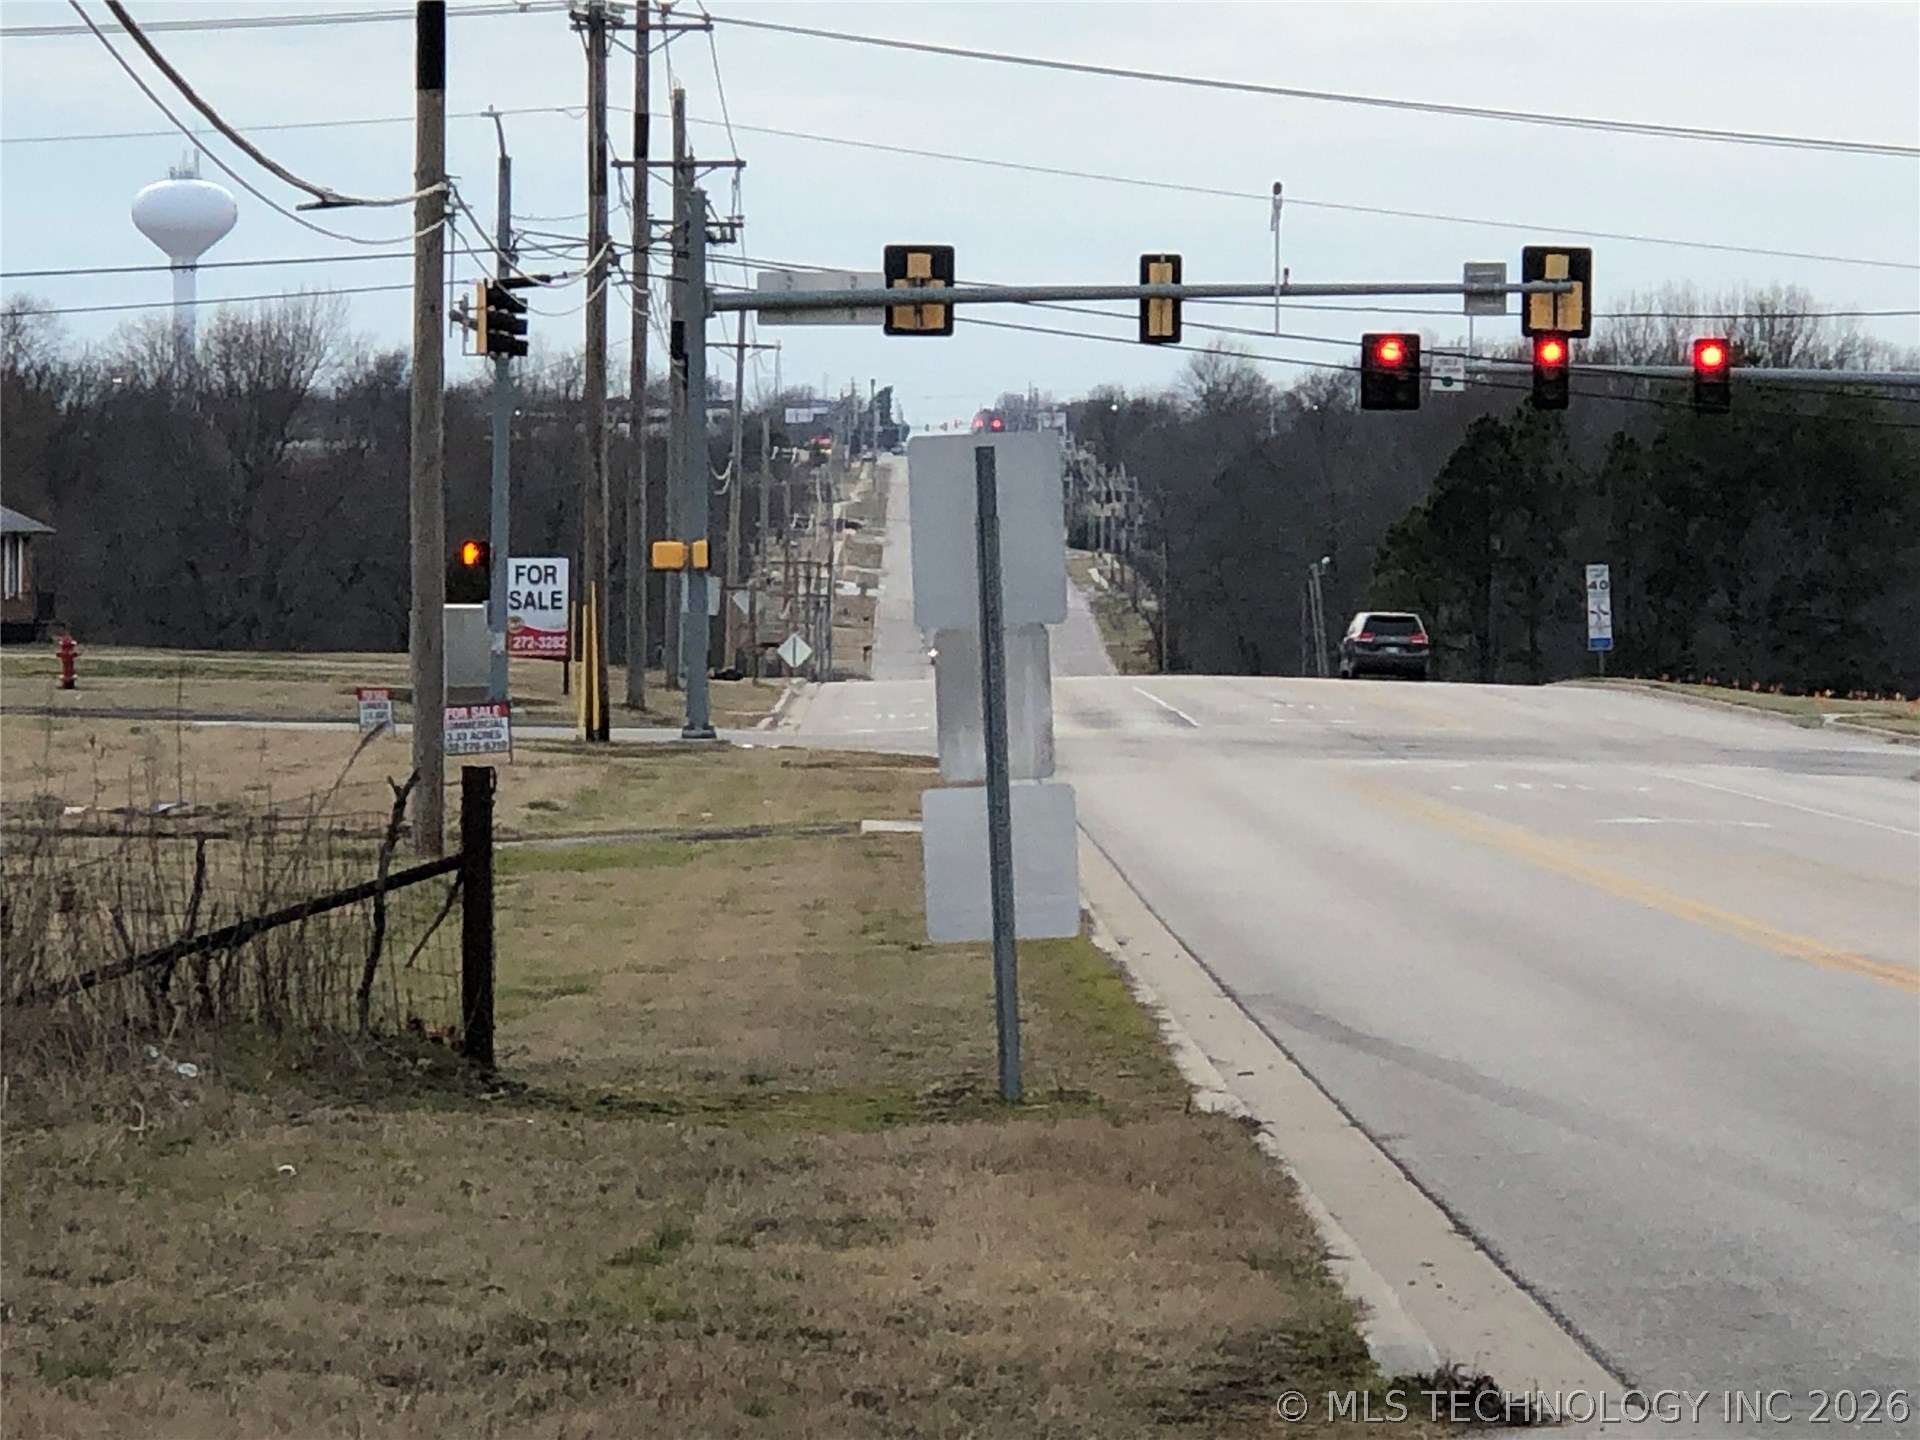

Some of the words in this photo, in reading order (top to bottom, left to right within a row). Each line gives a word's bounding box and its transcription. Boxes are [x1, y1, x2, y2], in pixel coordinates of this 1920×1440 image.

[515, 564, 558, 586] FOR
[1587, 579, 1609, 591] 40
[509, 590, 563, 611] SALE
[444, 706, 468, 720] FOR
[470, 704, 501, 719] SALE
[470, 729, 502, 740] ACRES
